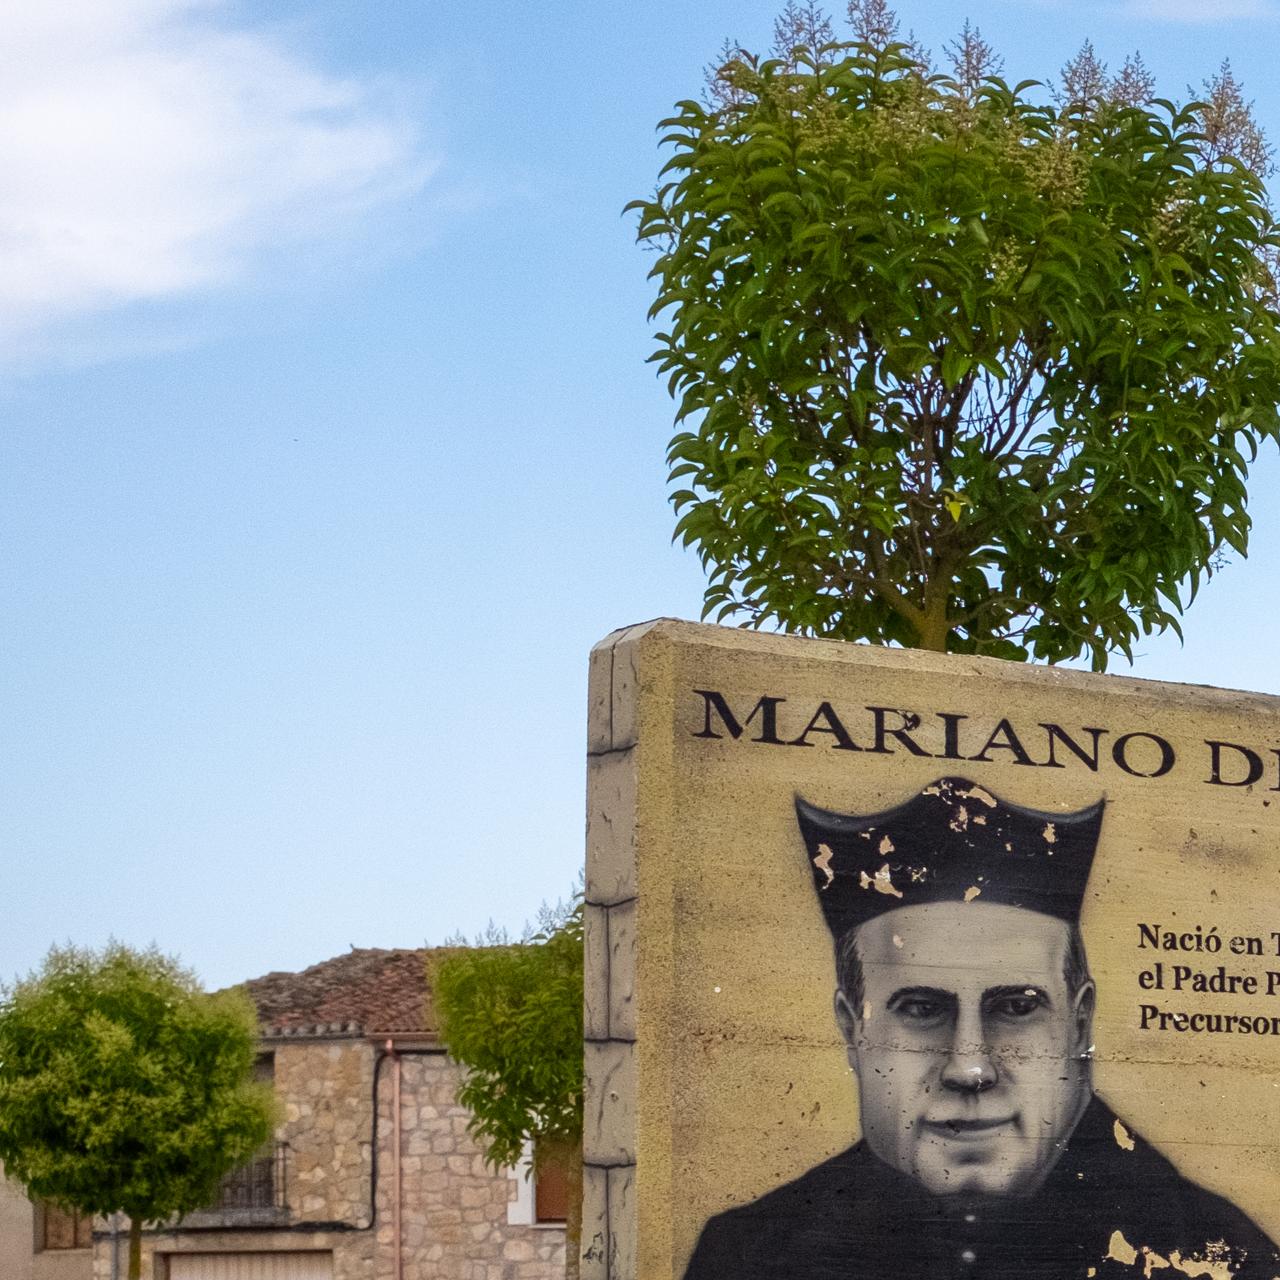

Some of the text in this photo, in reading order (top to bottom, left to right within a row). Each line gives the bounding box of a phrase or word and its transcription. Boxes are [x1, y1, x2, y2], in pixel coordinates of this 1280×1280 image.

[692, 689, 1176, 778] MARIANO
[1137, 923, 1222, 953] Nació
[1229, 934, 1264, 955] en
[1138, 963, 1164, 990] el
[1172, 965, 1257, 994] Padre
